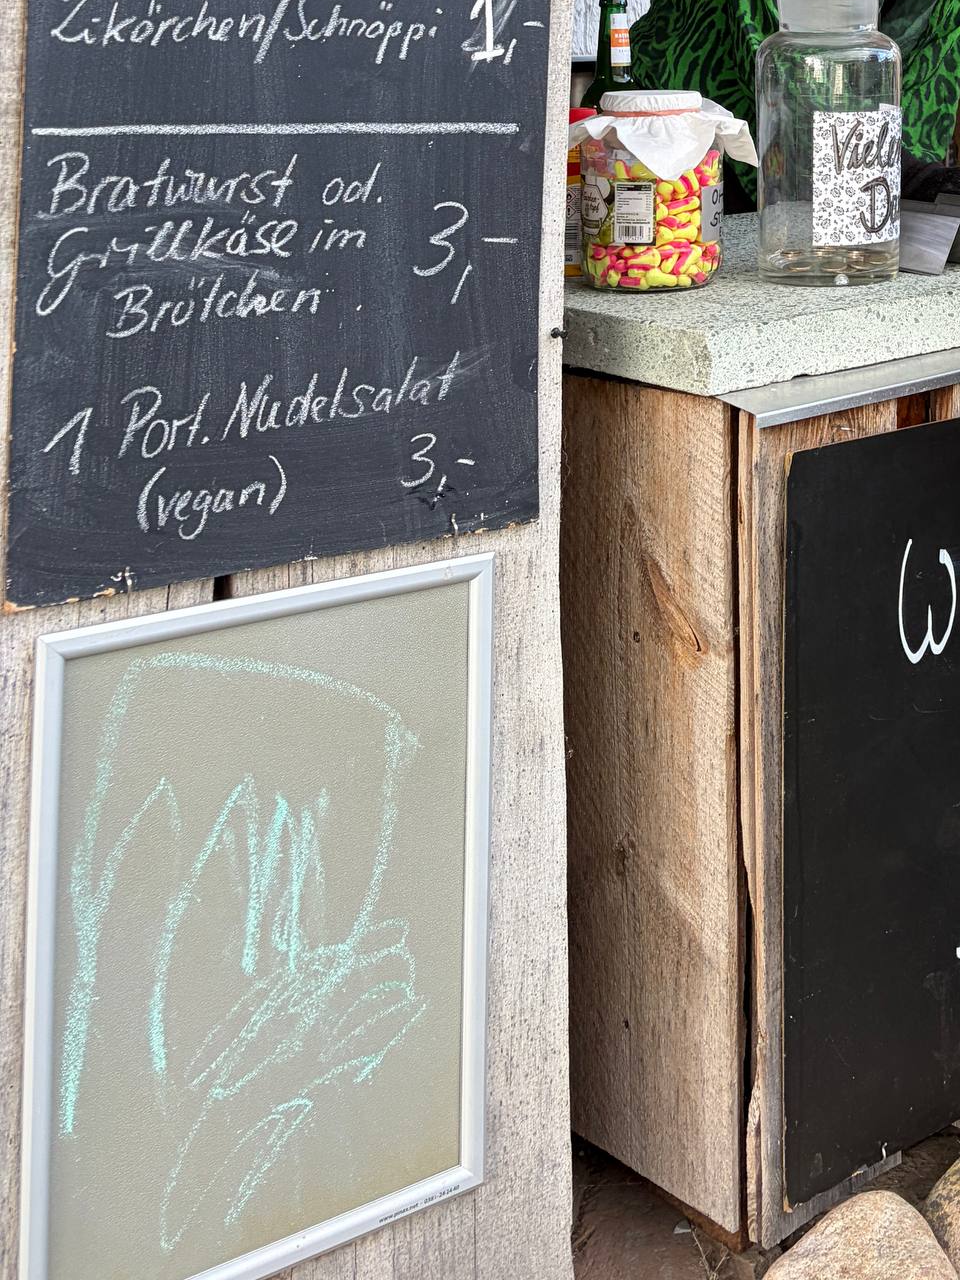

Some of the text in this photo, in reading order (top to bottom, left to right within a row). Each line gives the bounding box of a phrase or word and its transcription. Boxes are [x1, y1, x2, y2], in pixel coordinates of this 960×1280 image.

[37, 151, 384, 218] Bratwurst od.
[36, 211, 300, 317] Grillkäse
[308, 219, 367, 254] im
[105, 271, 322, 339] Brötchen
[43, 350, 461, 476] 1 Port. Nudelsalat
[137, 455, 287, 541] (vegan)
